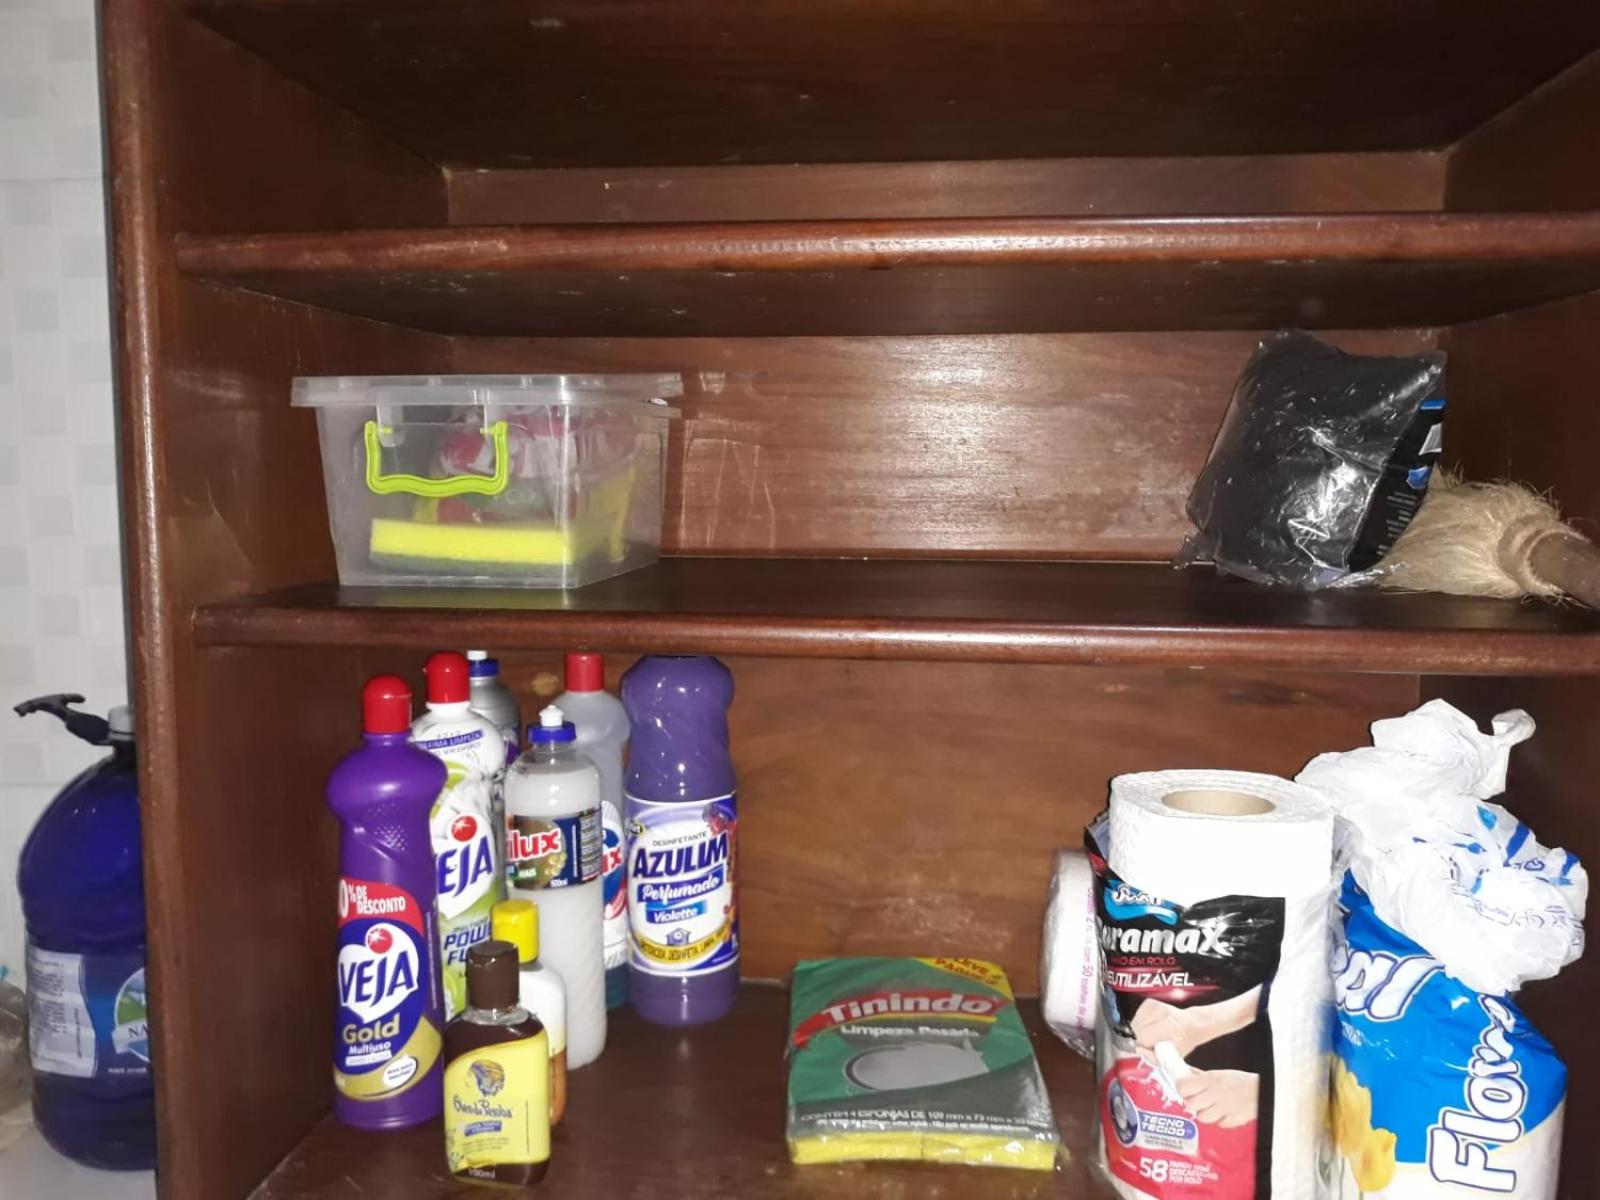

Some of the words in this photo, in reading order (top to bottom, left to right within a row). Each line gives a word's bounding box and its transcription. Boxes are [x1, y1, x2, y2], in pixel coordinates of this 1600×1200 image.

[652, 831, 708, 847] DESINFETANTE
[633, 832, 729, 878] AZULIM
[642, 874, 719, 905] Perfumado
[357, 895, 406, 914] DESCONTO
[654, 907, 699, 923] Violette
[1147, 957, 1176, 966] ROLO
[340, 950, 414, 1007] VEJA
[819, 993, 992, 1023] Tinindo
[343, 1013, 400, 1044] Gold
[840, 1025, 914, 1037] Limpeza
[348, 1041, 392, 1055] Multiuso
[911, 1110, 926, 1119] DE
[1143, 1115, 1185, 1128] TECNO
[1141, 1122, 1186, 1137] TECIDO
[1139, 1157, 1169, 1183] 58
